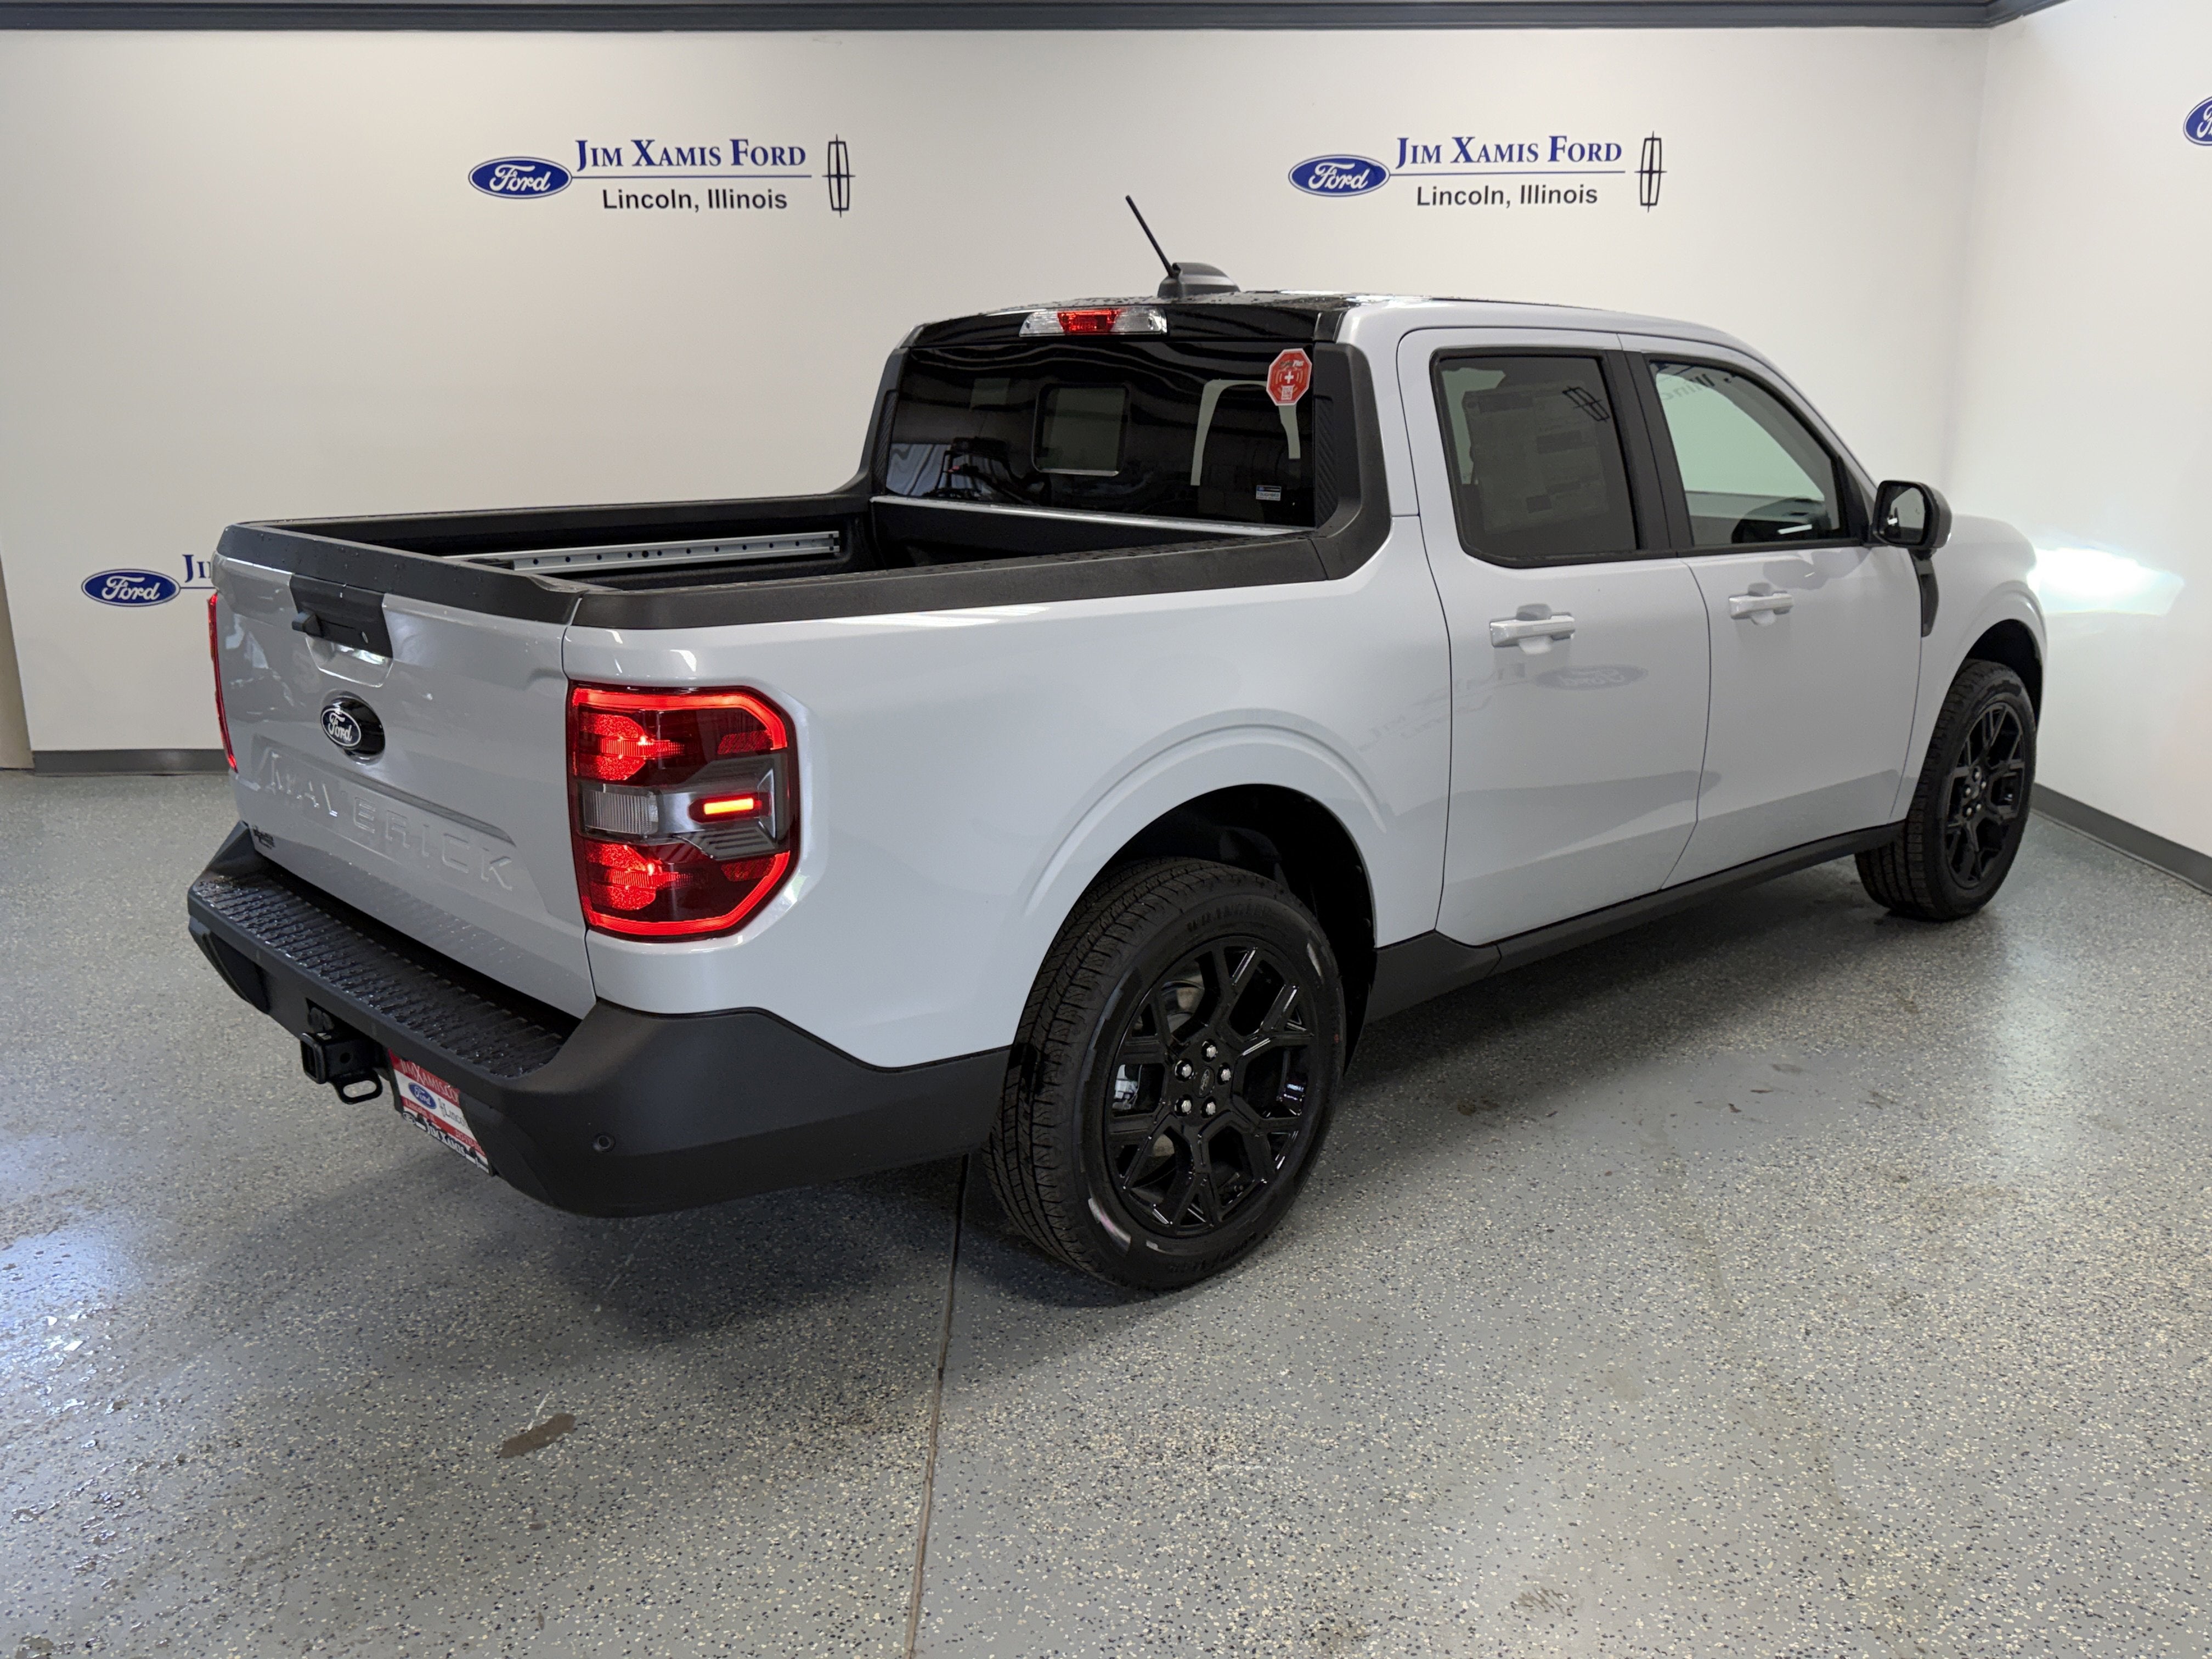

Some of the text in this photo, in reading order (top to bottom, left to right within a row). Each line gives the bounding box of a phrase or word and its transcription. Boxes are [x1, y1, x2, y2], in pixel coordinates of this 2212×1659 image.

[576, 139, 806, 172] JIM XAMIS FORD
[1395, 136, 1622, 170] JIM XAMIS FORD
[489, 165, 551, 192] Ford
[1307, 163, 1369, 190] Ford
[603, 189, 787, 212] Lincoln, Illinois
[1417, 184, 1598, 208] Lincoln, Illinois
[101, 575, 161, 600] Ford
[328, 712, 353, 742] Ford
[414, 1085, 432, 1106] Ford
